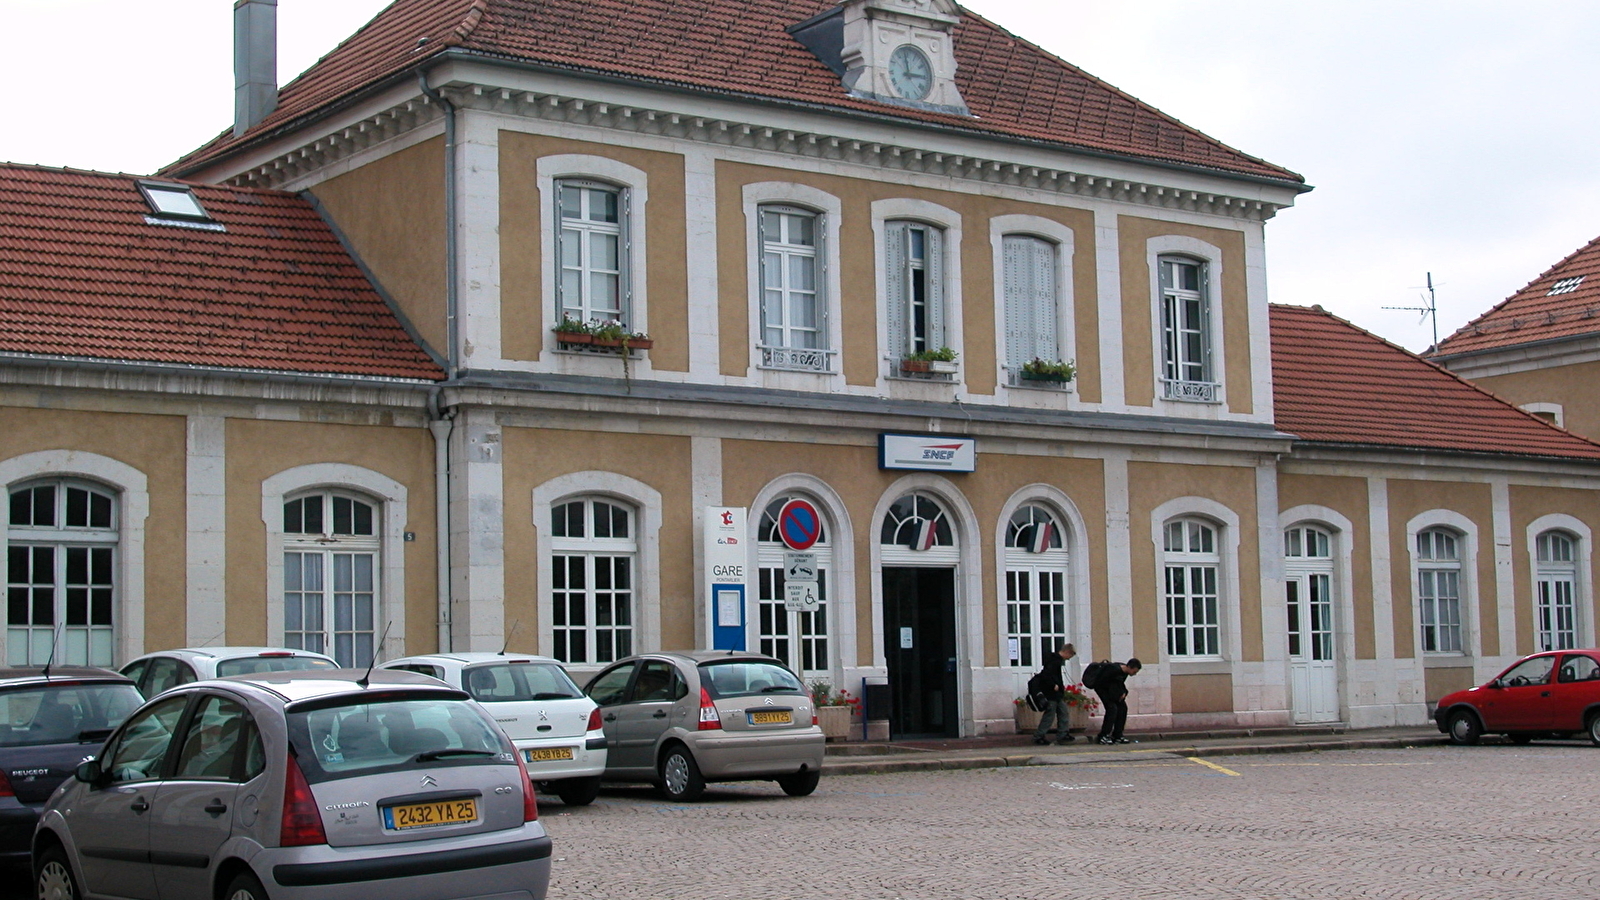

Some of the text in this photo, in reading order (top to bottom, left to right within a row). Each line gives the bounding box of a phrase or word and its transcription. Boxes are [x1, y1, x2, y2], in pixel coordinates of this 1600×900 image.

[922, 449, 955, 460] SNCF
[407, 532, 413, 541] 5
[713, 565, 743, 577] GARE
[780, 712, 790, 721] 25
[531, 748, 571, 760] 2438 YB 25
[495, 786, 512, 795] C3
[398, 802, 474, 825] 2432 YA 25
